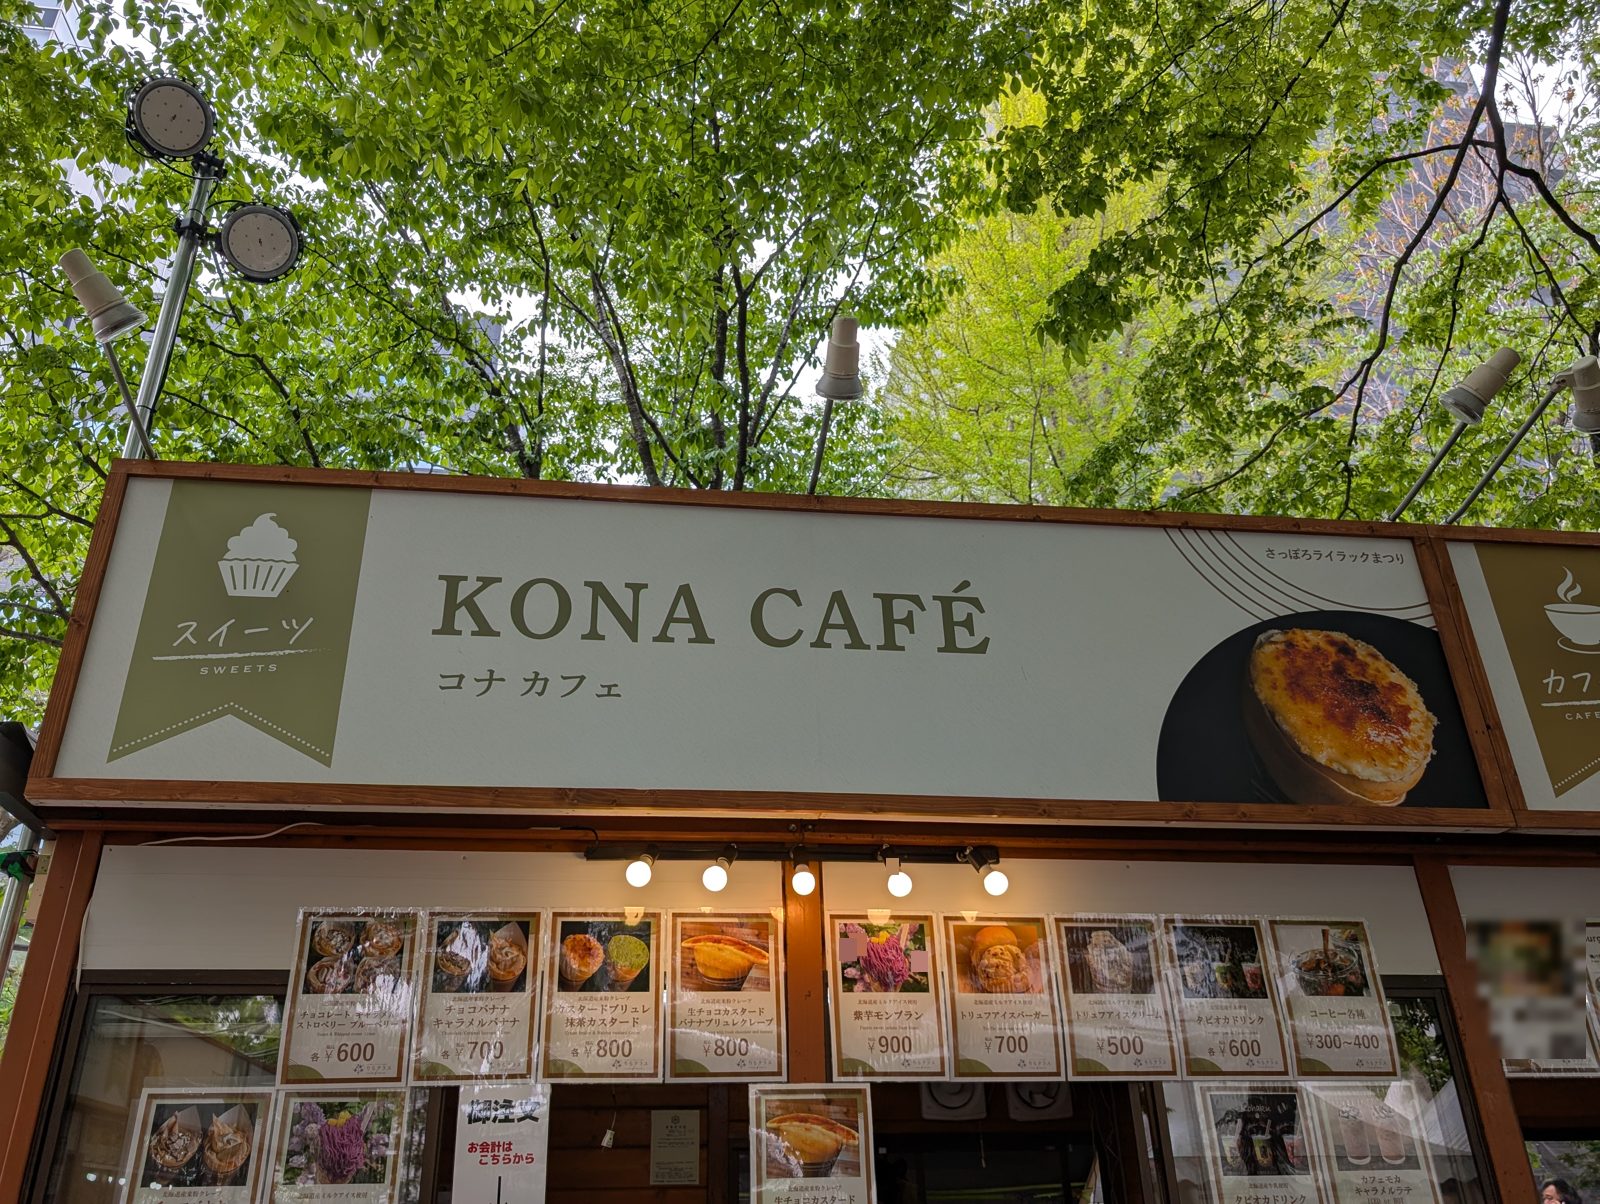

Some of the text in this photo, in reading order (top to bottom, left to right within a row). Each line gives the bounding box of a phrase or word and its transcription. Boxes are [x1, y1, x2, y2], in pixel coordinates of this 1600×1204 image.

[1265, 547, 1405, 565] さっぽろライラックまつり
[431, 574, 991, 655] KONA CAFÉ
[172, 616, 315, 648] スイーツ
[199, 663, 278, 675] SWEETS
[438, 668, 622, 698] コナ カフェ
[1542, 668, 1600, 695] カフ
[444, 1004, 511, 1016] チョコバナナ
[553, 1003, 651, 1015] カスタードブリュレ
[687, 1007, 765, 1017] 生チョコカスタード
[960, 1010, 1049, 1020] トリュフアイスバーガー
[1075, 1010, 1164, 1020] トリュフアイスクリーム
[853, 1010, 924, 1021] 紫芋モンブラン
[1196, 1015, 1265, 1026] タピオカドリンク
[296, 1021, 347, 1030] ストロベリー
[432, 1017, 520, 1029] キャラメルバナナ
[564, 1016, 640, 1028] 抹茶カスタード
[678, 1017, 774, 1028] バナナブリュレクレープ
[467, 1141, 514, 1154] お会計は
[478, 1153, 536, 1166] こちらから
[1355, 1186, 1413, 1197] キャラメルラテ
